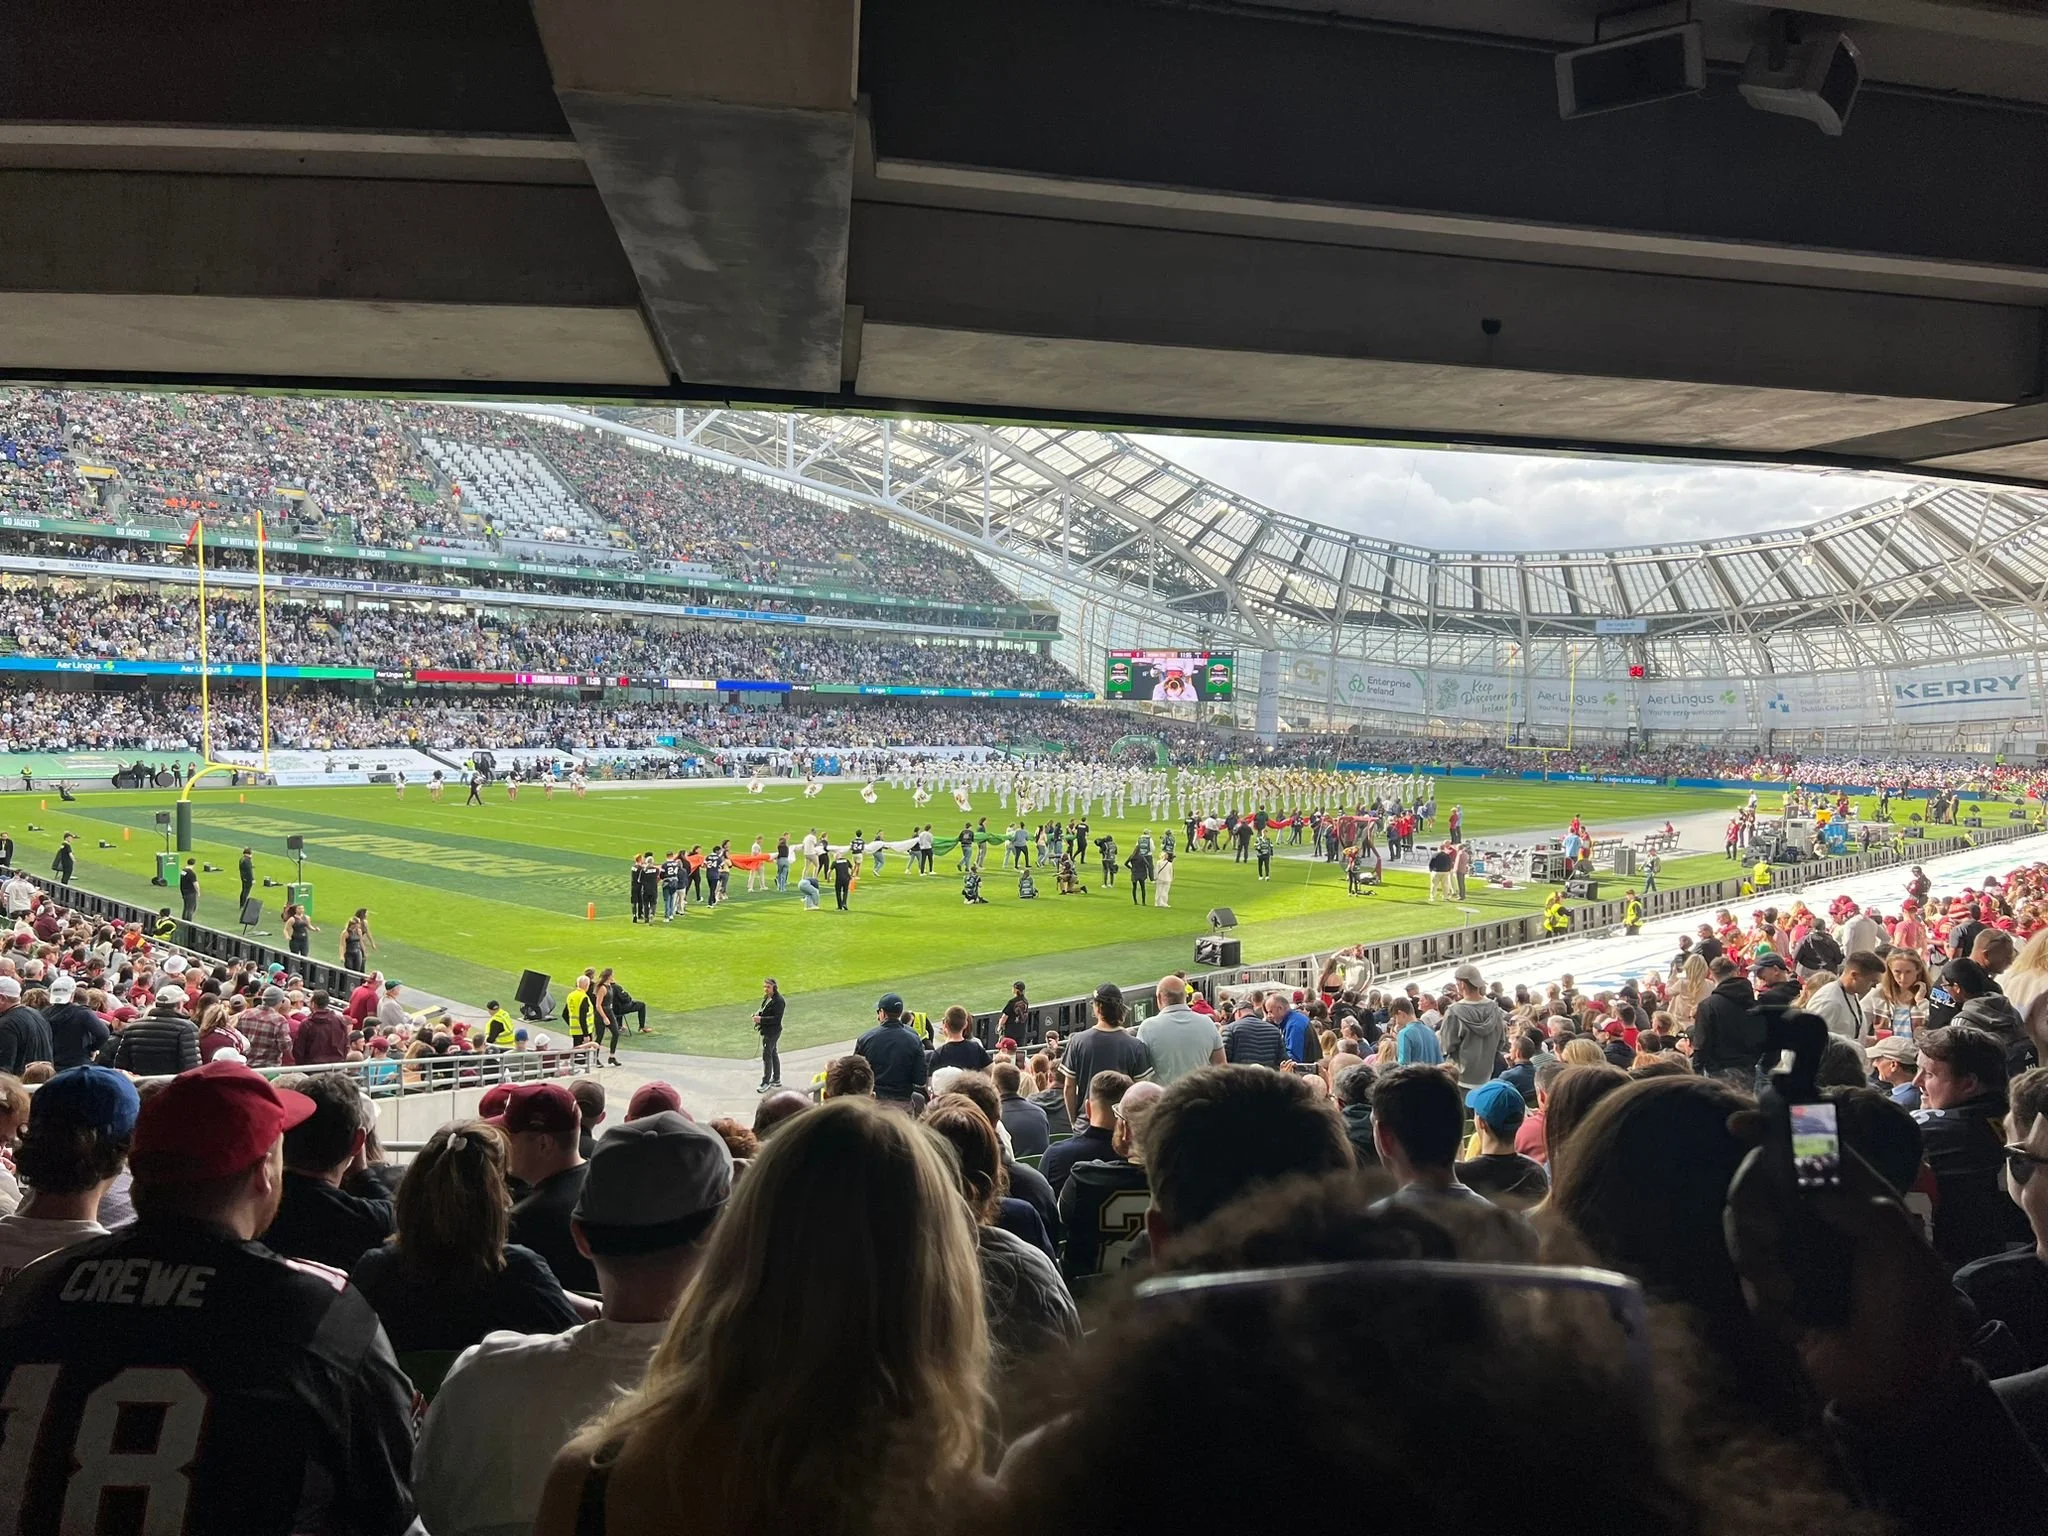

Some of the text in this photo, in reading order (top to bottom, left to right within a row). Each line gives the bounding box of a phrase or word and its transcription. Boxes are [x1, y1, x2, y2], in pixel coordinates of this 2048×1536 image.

[3, 517, 40, 528] GO JACKETS
[116, 527, 150, 538] GO JACKETS
[310, 580, 364, 590] visitdublin.com
[56, 661, 100, 671] Aer Lingus
[180, 665, 220, 674] Aer Ligus
[1630, 666, 1643, 675] 25
[387, 671, 404, 679] Lingus
[1367, 676, 1411, 689] Enterprise
[1472, 680, 1494, 694] Keep
[1896, 674, 2024, 700] KERRY
[1367, 685, 1395, 696] Ireland
[1537, 691, 1557, 701] Aer
[1461, 691, 1517, 707] Discovering
[1647, 694, 1715, 707] Aer Lingus
[668, 866, 679, 875] 24
[59, 1258, 216, 1307] CREWE
[0, 1362, 208, 1536] 18
